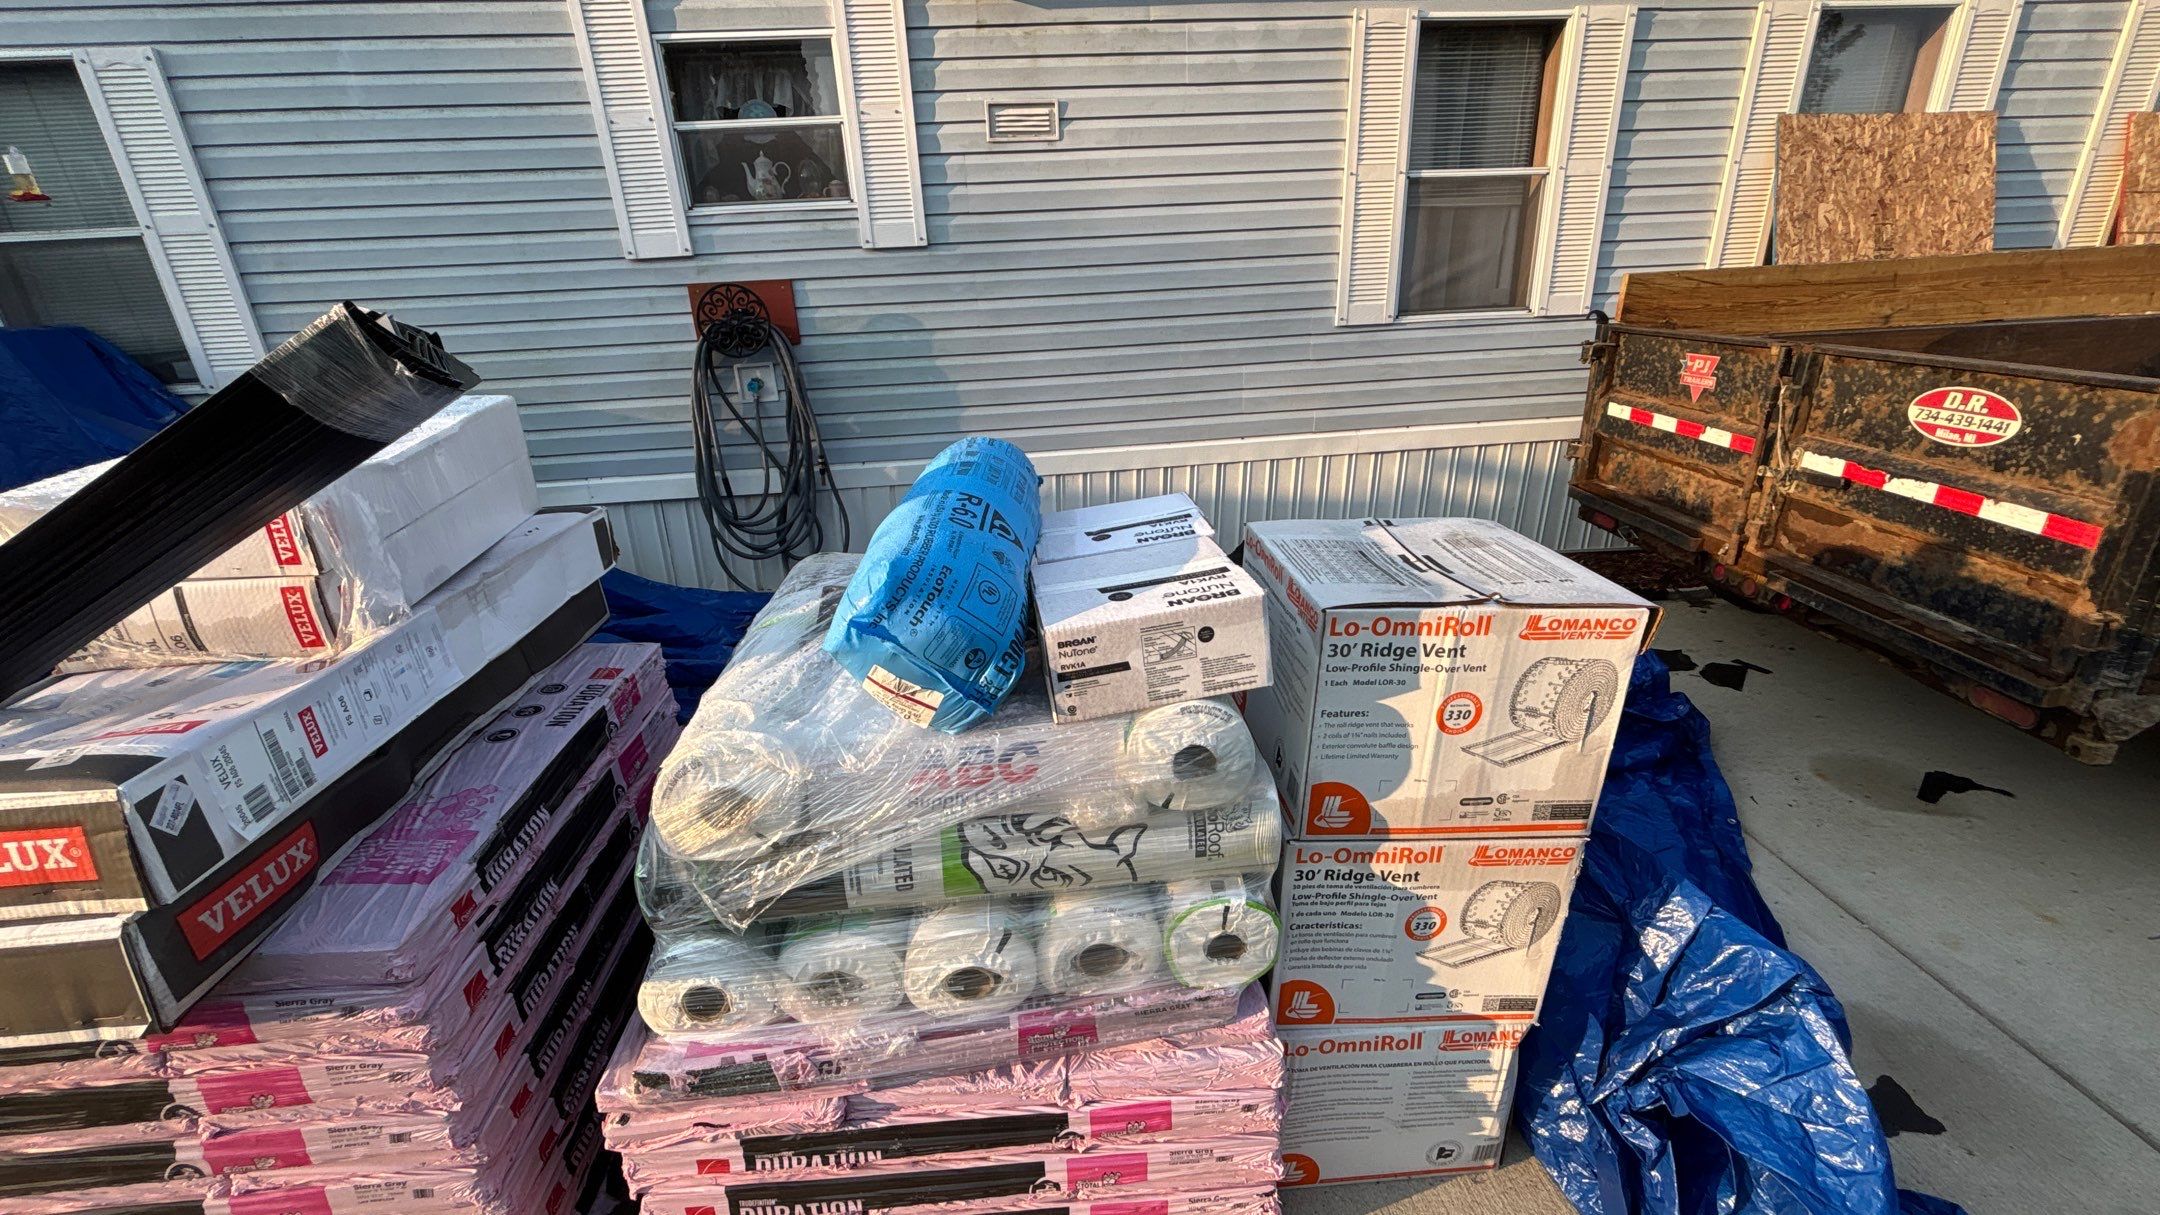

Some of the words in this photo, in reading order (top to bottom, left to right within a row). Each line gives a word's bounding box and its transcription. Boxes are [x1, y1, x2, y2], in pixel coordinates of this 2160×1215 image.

[1692, 359, 1711, 373] PJ
[1943, 391, 1990, 414] D.R.
[1914, 408, 2012, 434] 734-439-1441
[1134, 523, 1193, 538] NuTone
[1137, 529, 1196, 544] BROAN
[1179, 573, 1228, 586] RVK1A
[1162, 580, 1236, 599] NuTone
[1167, 588, 1242, 608] BROAN
[286, 591, 320, 644] VELUX
[1525, 614, 1638, 632] LOMANCO
[1329, 615, 1492, 637] Lo-OmniRoll
[1560, 631, 1604, 640] VENTS
[1057, 636, 1097, 650] BROAN
[1058, 646, 1098, 659] NuTone
[1360, 642, 1418, 661] Ridge
[1422, 643, 1467, 659] Vent
[1060, 661, 1086, 671] RVK1A
[1326, 663, 1387, 674] Low-Profile
[1389, 663, 1462, 675] Shingle-Over
[1463, 664, 1487, 673] Vent
[1352, 679, 1378, 687] Model
[1320, 709, 1370, 718] Features:
[1445, 709, 1472, 721] 330
[302, 709, 323, 754] VELUX
[1347, 722, 1365, 730] ridge
[1370, 753, 1399, 761] Warranty
[210, 755, 233, 791] VELUX
[0, 837, 78, 873] LUX
[1295, 845, 1444, 865] Lo-OmniRoll
[1474, 845, 1577, 859] LOMANCO
[1507, 858, 1547, 866] VENTS
[1324, 869, 1375, 884] Ridge
[1380, 870, 1421, 882] Vent
[197, 836, 314, 934] VELUX
[1292, 892, 1347, 901] Low-Profile
[1349, 893, 1414, 902] Shingle-Over
[1289, 922, 1363, 931] Características:
[1413, 921, 1437, 931] 330
[325, 1064, 356, 1072] Sierra
[359, 1062, 384, 1070] Gray
[327, 1126, 358, 1134] Sierra
[353, 1183, 382, 1191] Sierra
